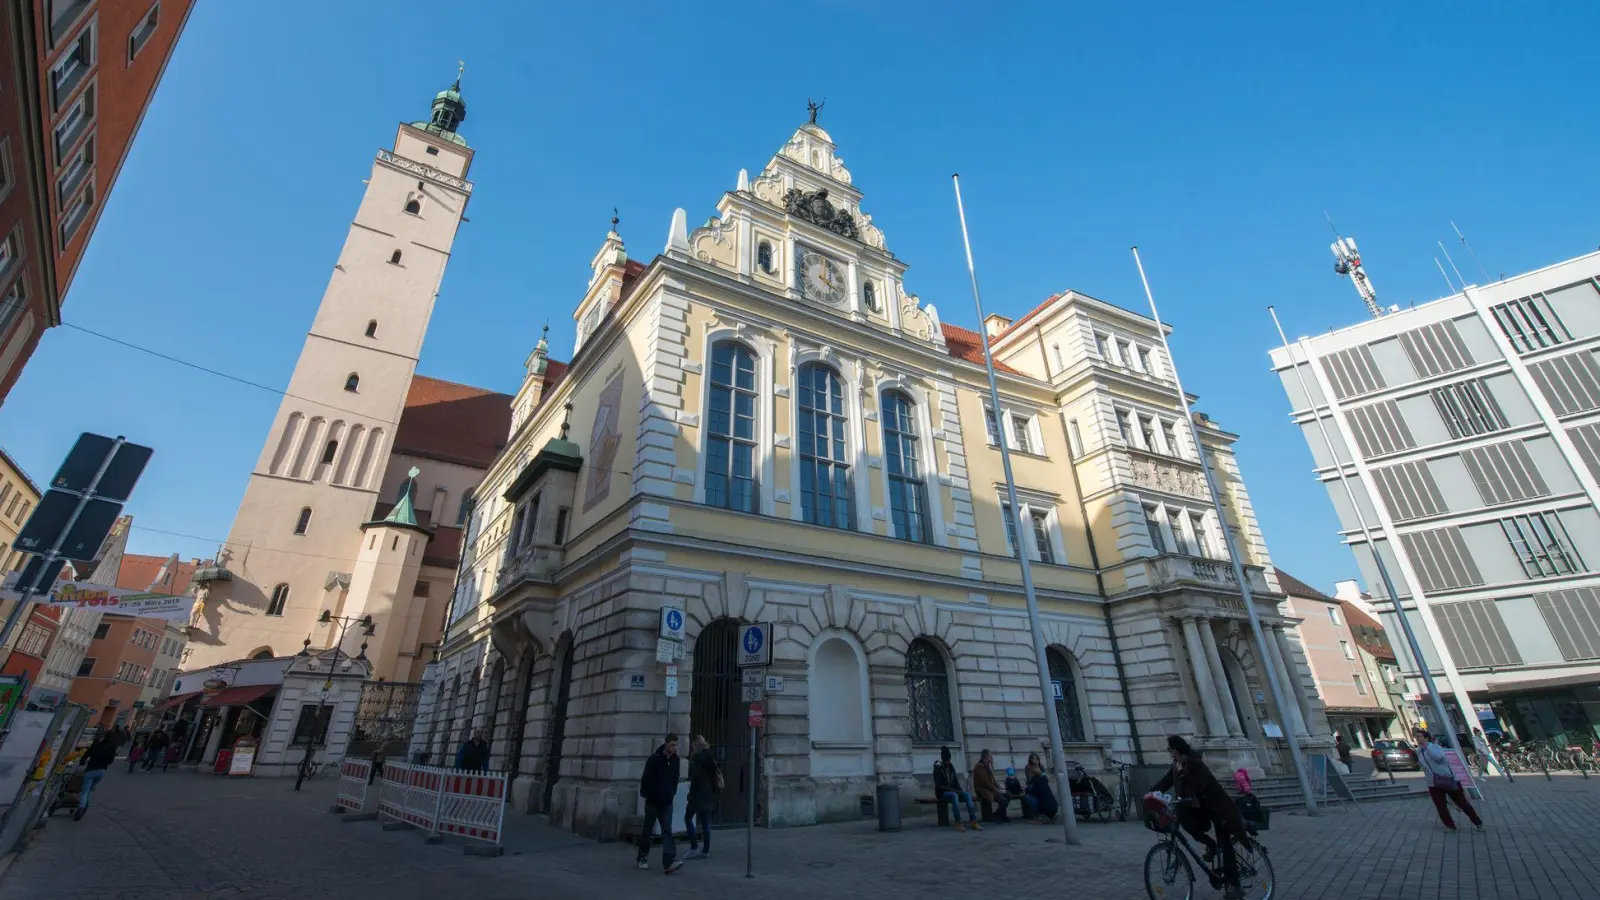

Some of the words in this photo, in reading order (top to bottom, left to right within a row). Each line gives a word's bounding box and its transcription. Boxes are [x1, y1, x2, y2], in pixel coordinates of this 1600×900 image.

[77, 594, 119, 607] 2015
[144, 599, 162, 607] März
[163, 597, 180, 605] 2015
[667, 630, 679, 638] ZONE
[744, 654, 761, 663] ZONE
